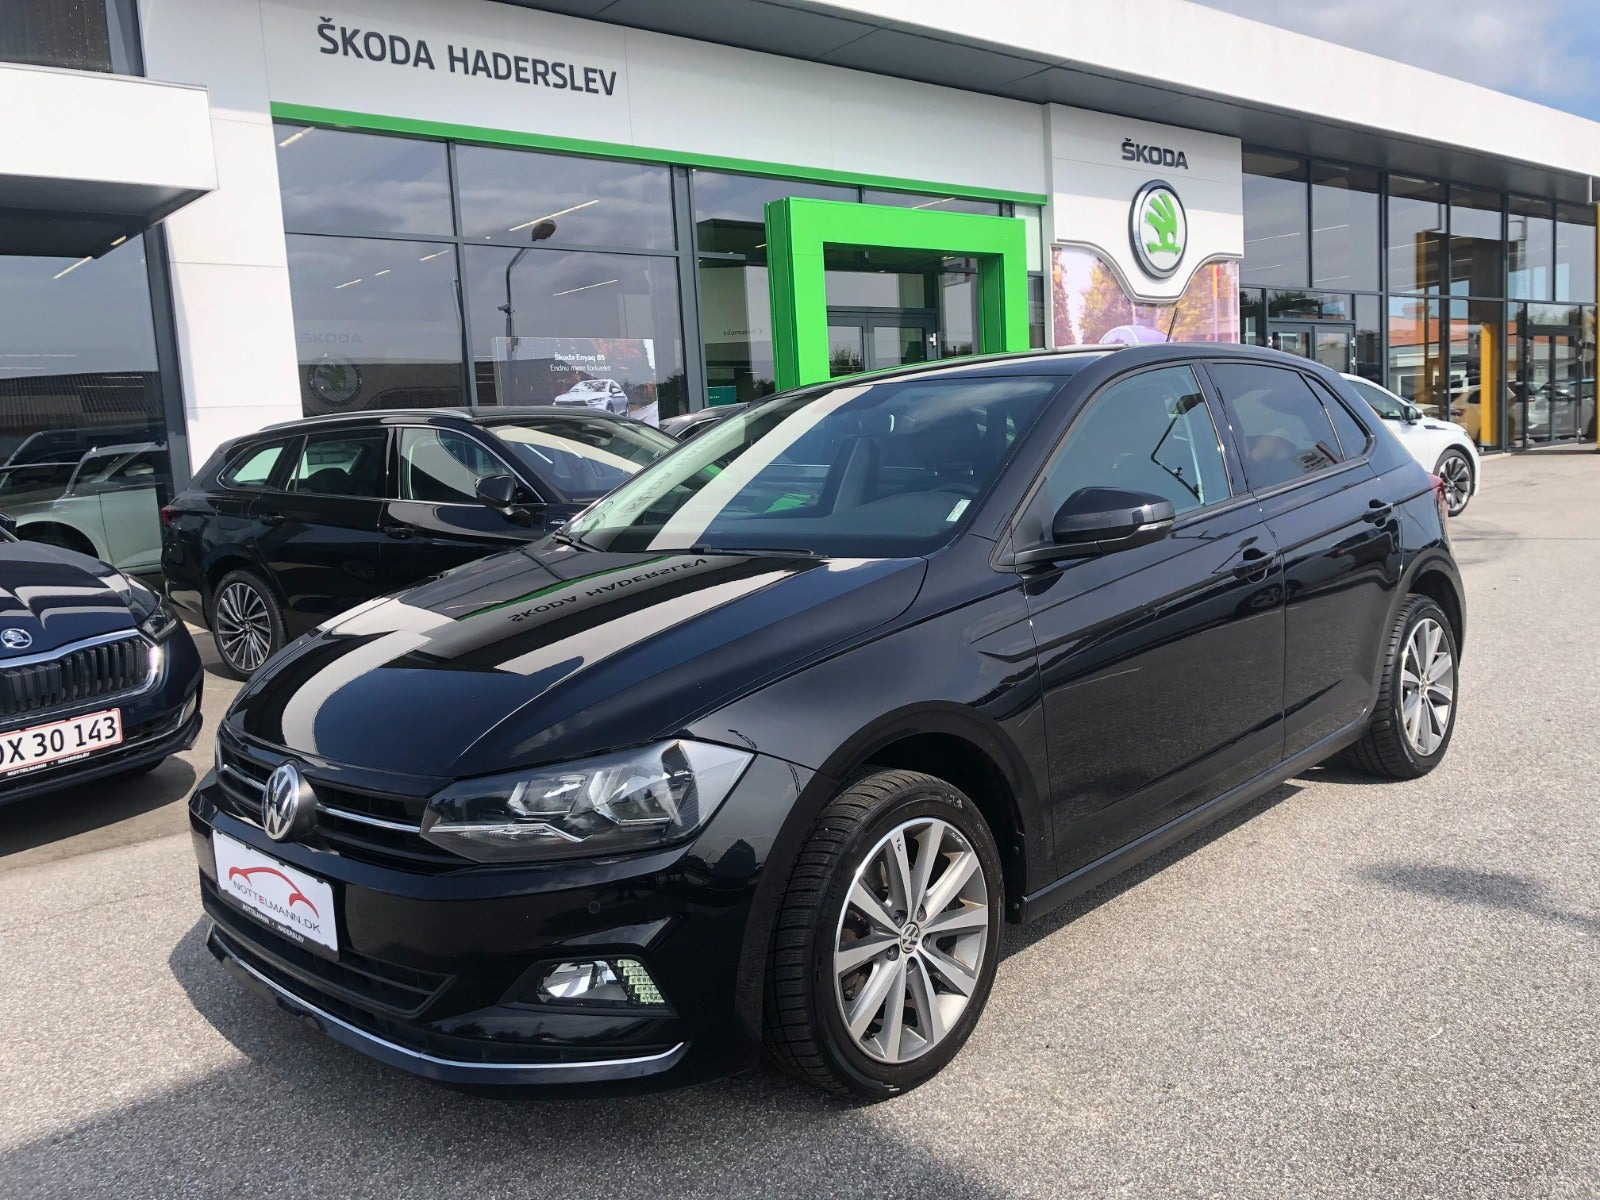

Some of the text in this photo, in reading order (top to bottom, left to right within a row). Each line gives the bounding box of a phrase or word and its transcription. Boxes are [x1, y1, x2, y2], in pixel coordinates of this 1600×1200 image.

[316, 16, 617, 96] ŠKODA HADERSLEV
[1121, 137, 1189, 169] ŠKODA
[577, 353, 596, 362] Enyaq
[32, 728, 65, 757] 30
[74, 716, 117, 747] 143
[7, 752, 90, 776] NOTTELMANN HADERSLEV
